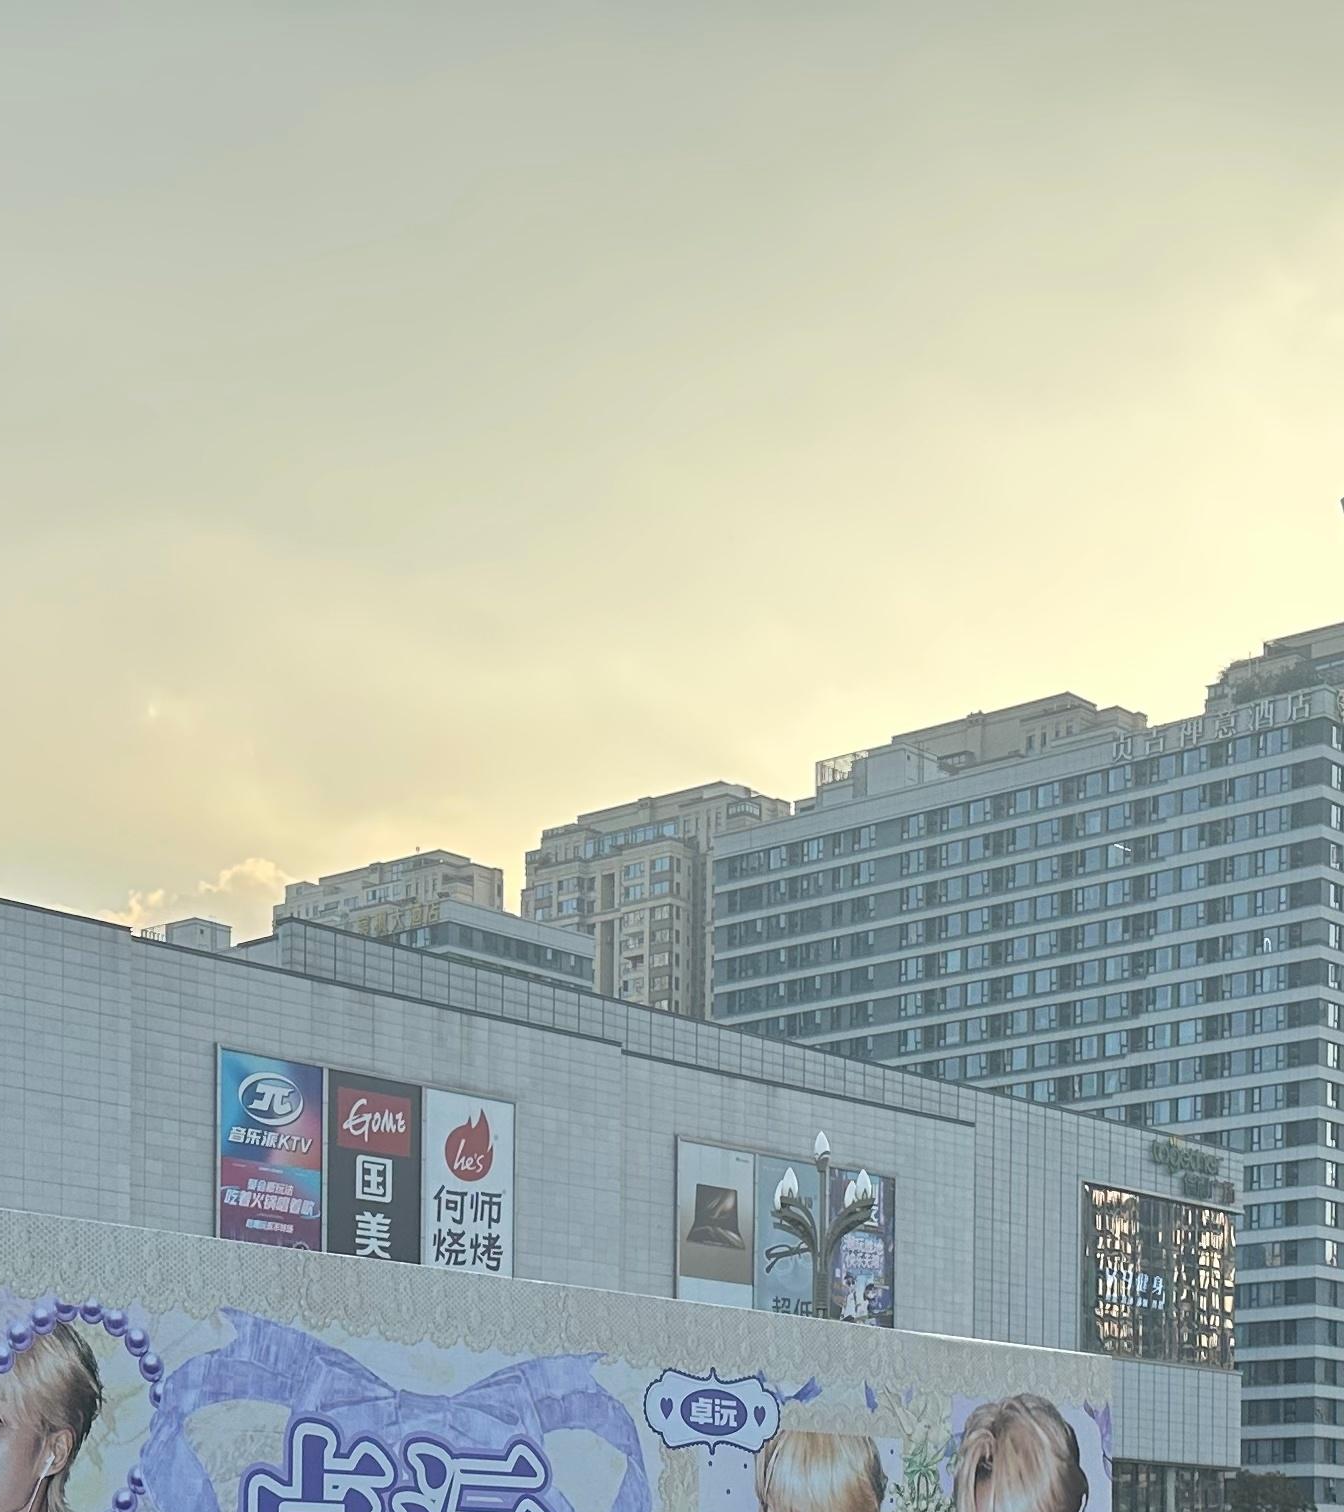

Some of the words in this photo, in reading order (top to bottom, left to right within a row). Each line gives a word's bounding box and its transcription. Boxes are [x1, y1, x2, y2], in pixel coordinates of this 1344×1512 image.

[227, 1126, 313, 1153] 音乐派KTV
[433, 1184, 502, 1229] 何师
[432, 1228, 503, 1271] 烧烤
[689, 1397, 738, 1427] 卓沅
